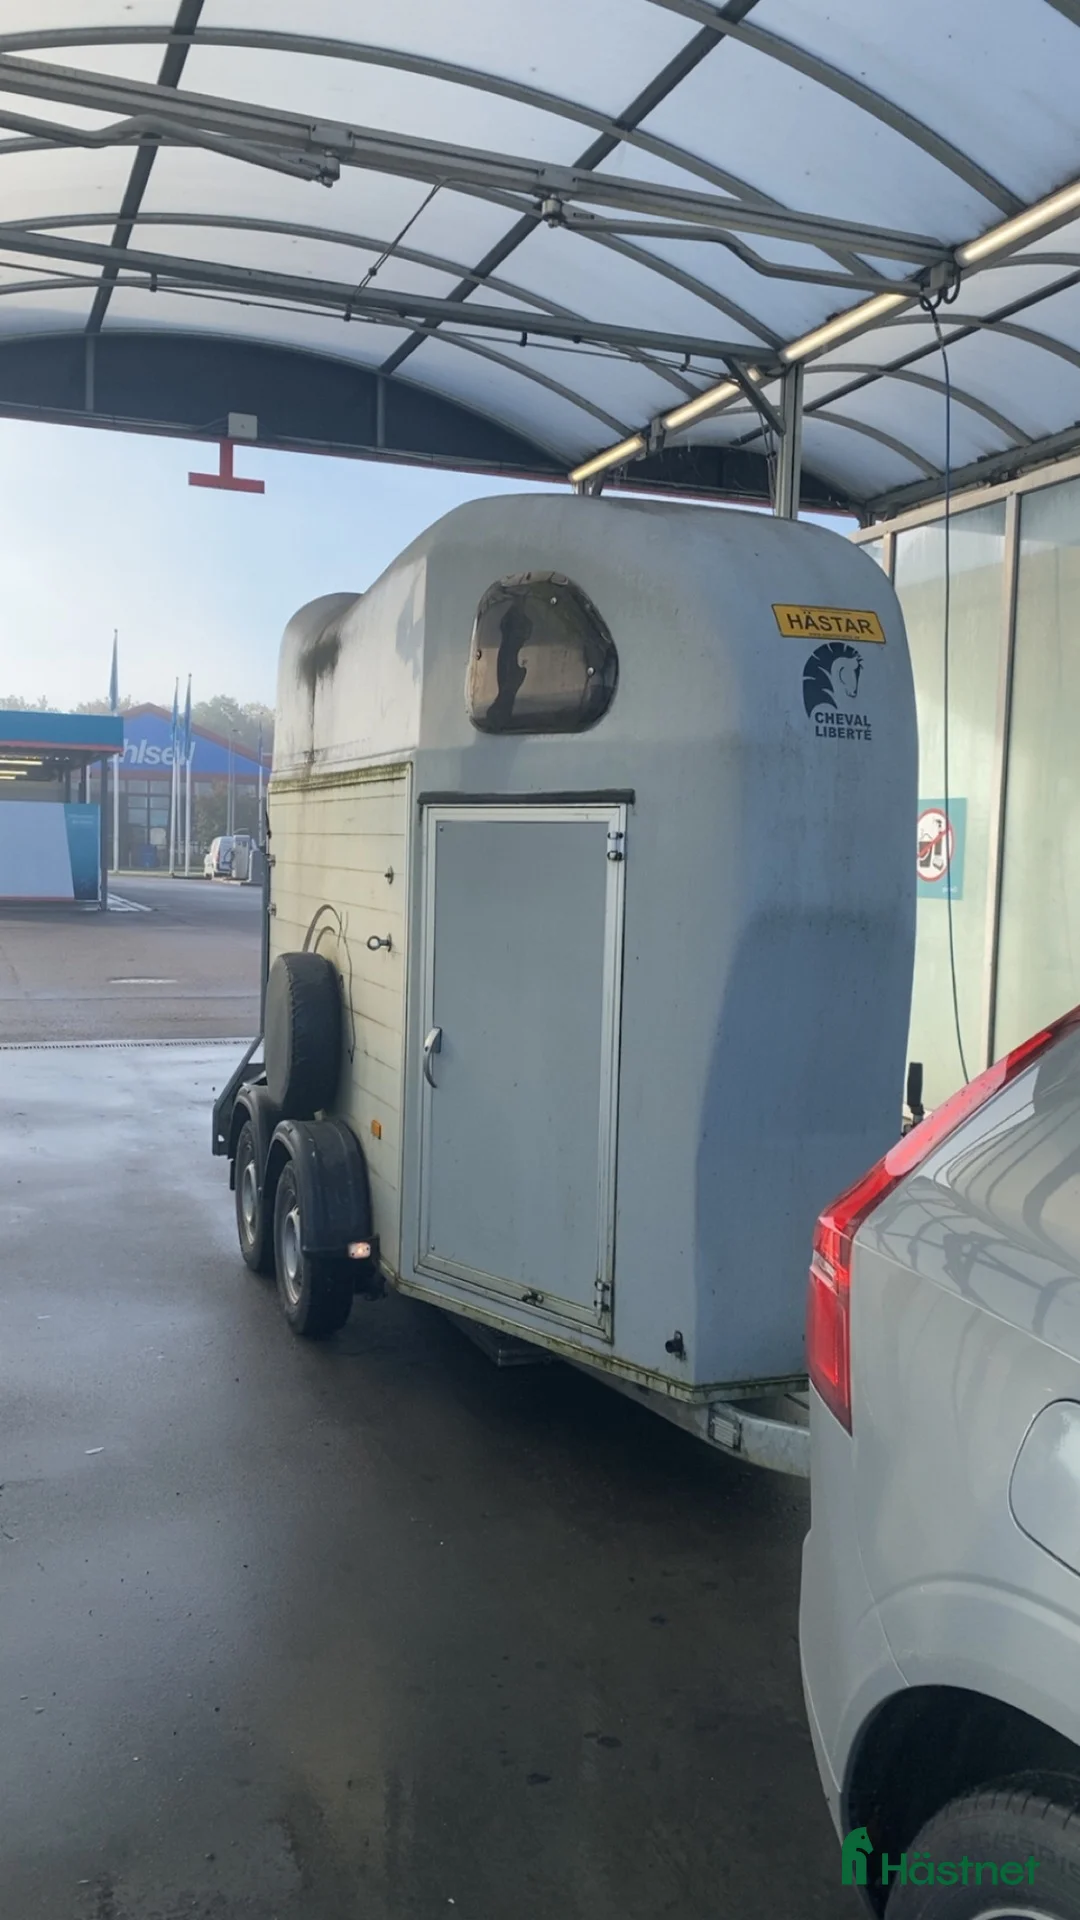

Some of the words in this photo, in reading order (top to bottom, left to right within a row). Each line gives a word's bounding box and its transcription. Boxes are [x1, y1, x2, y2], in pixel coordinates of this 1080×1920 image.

[786, 611, 875, 635] HÄSTAR
[814, 711, 872, 727] CHEVAL
[815, 725, 872, 741] LIBERTÉ
